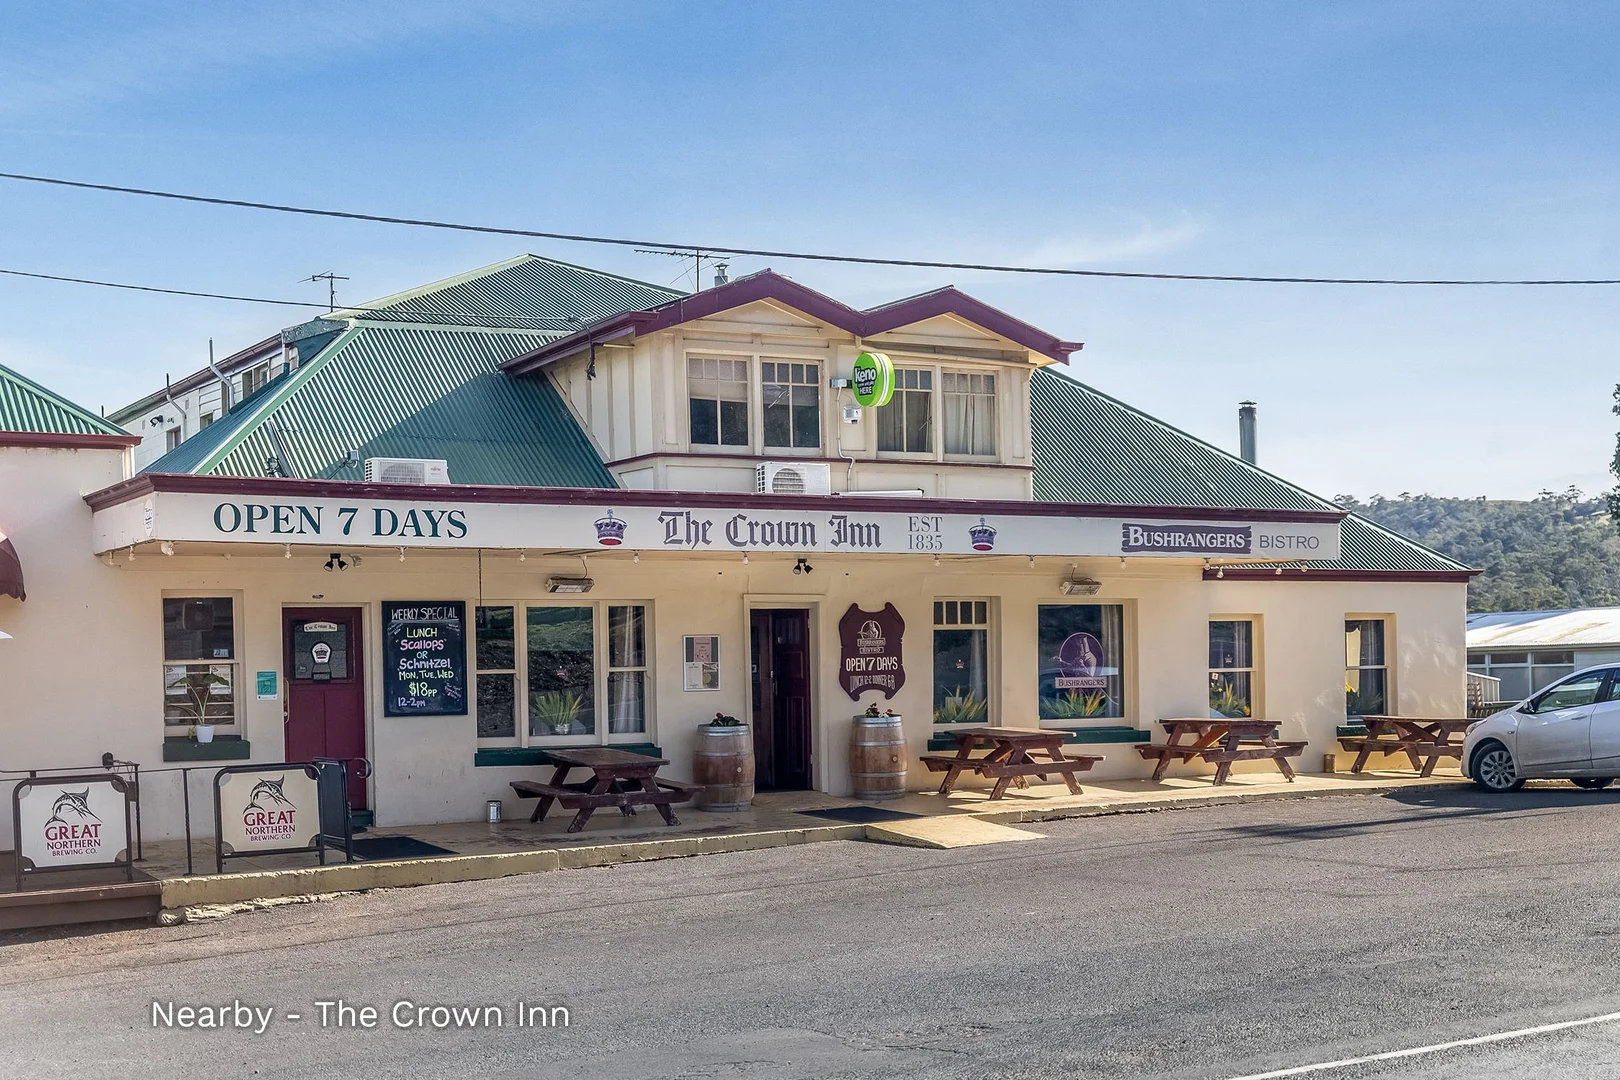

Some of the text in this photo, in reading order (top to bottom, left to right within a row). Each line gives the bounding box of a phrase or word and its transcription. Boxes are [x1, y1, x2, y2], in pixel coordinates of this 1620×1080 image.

[854, 367, 876, 382] keno
[213, 502, 468, 539] OPEN 7 DAYS
[908, 516, 943, 533] EST
[657, 510, 883, 550] The Crown Inn
[1128, 526, 1320, 549] BUSHRANGERS BISTRO
[908, 534, 943, 551] 1835
[391, 606, 458, 620] WEEKLY SPECIAL
[406, 627, 438, 638] LUNCH
[416, 650, 428, 659] OR
[845, 656, 898, 672] OPEN 7 DAYS
[1058, 679, 1105, 687] BUSHRANGERS
[244, 810, 296, 826] GREAT
[45, 823, 102, 841] GREAT
[245, 824, 296, 836] NORTHERN
[250, 833, 279, 842] BREWING
[46, 839, 101, 851] NORTHERN
[52, 849, 84, 857] BREWING
